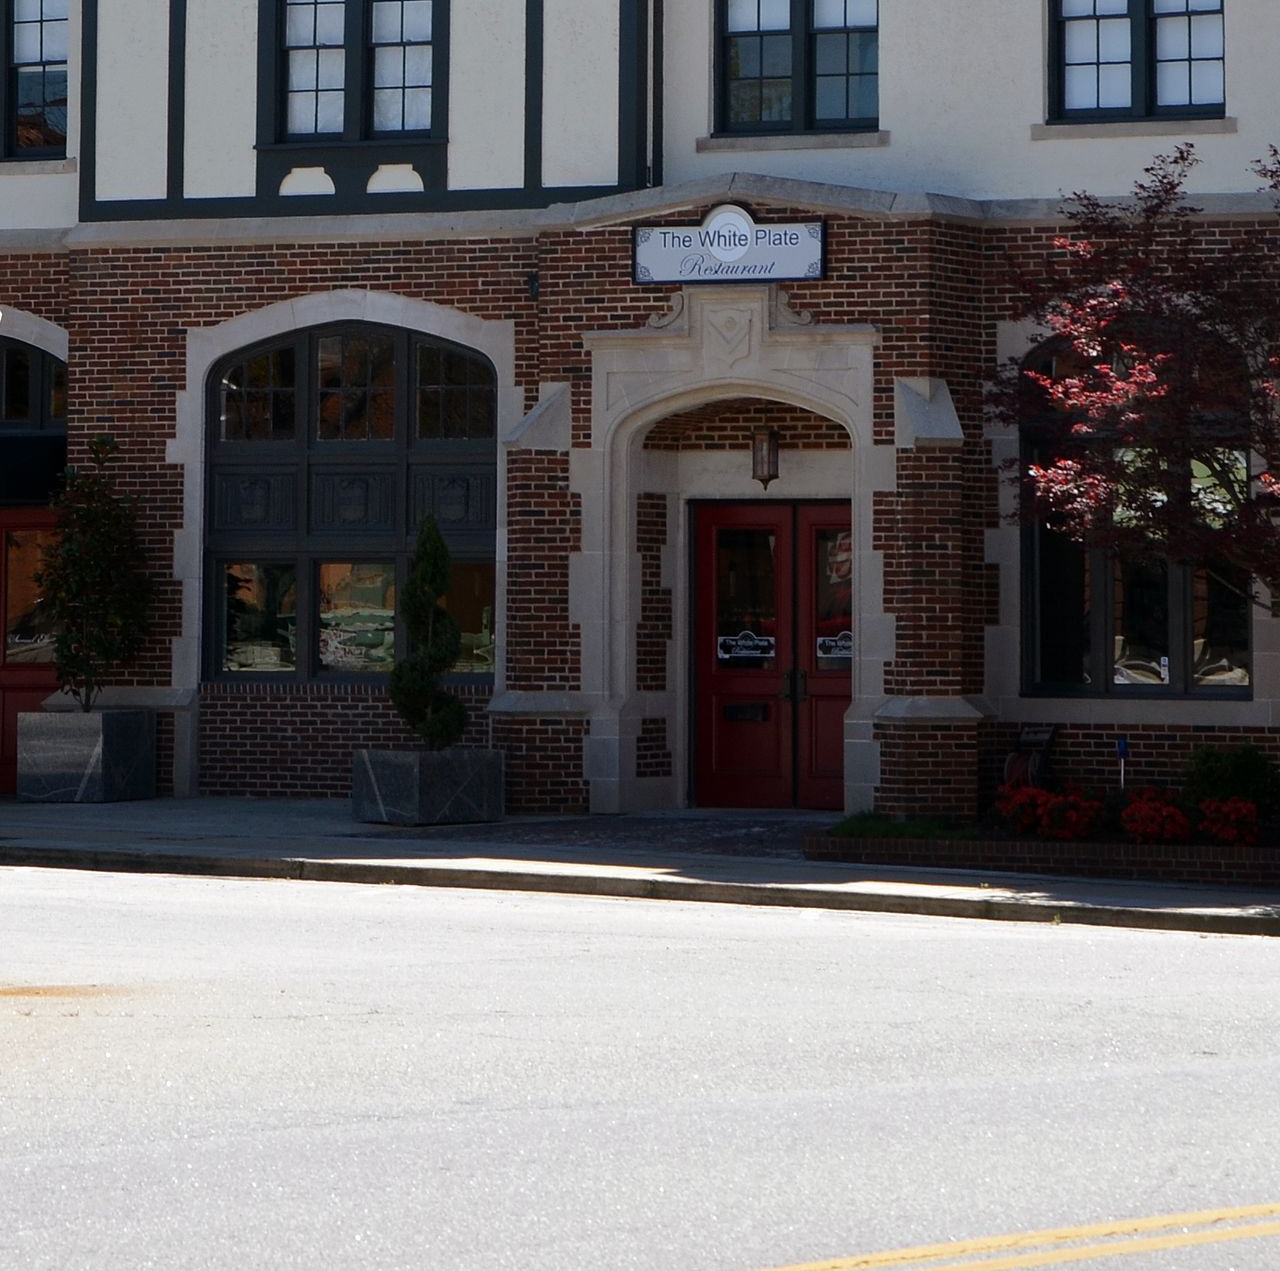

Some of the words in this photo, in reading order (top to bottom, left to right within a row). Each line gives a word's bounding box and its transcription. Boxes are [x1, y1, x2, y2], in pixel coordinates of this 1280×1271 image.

[659, 231, 692, 249] The
[698, 230, 749, 248] White
[755, 229, 800, 247] Plate
[679, 253, 776, 277] Restaurant
